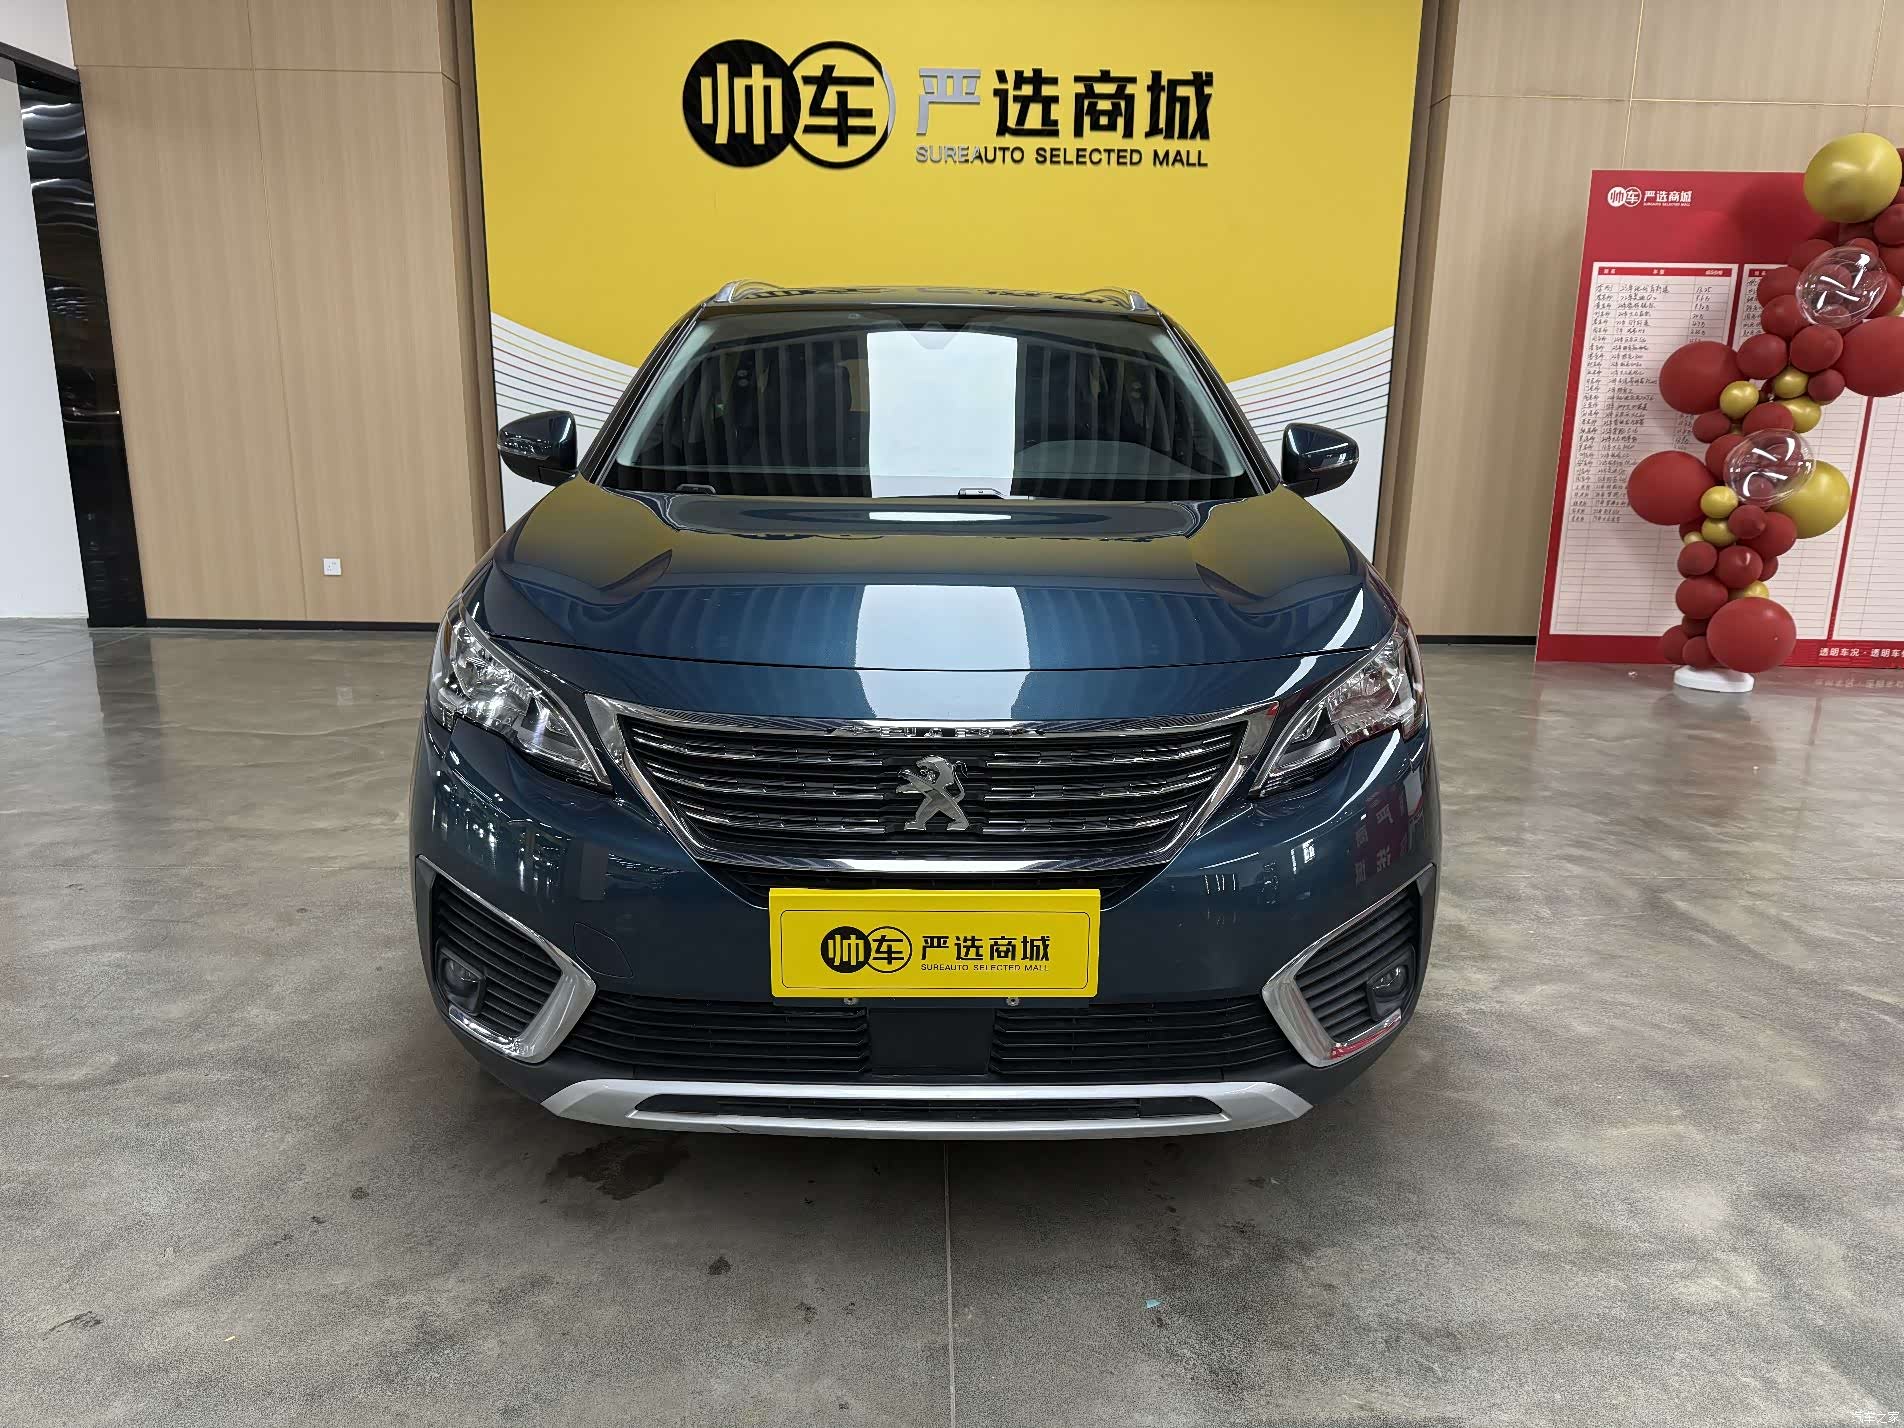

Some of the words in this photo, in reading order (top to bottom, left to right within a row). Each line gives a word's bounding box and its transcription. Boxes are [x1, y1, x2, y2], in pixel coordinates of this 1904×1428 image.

[700, 63, 877, 147] 帅车
[915, 67, 1214, 140] 严选商城
[915, 145, 1025, 165] SUREAUTO
[1035, 146, 1143, 166] SELECTED
[1153, 148, 1209, 167] MALL
[1643, 190, 1693, 203] 严选商城
[827, 934, 905, 966] 帅车
[921, 935, 1051, 962] 严选商城
[920, 963, 969, 971] SUREAUTO
[1024, 964, 1049, 972] MALL
